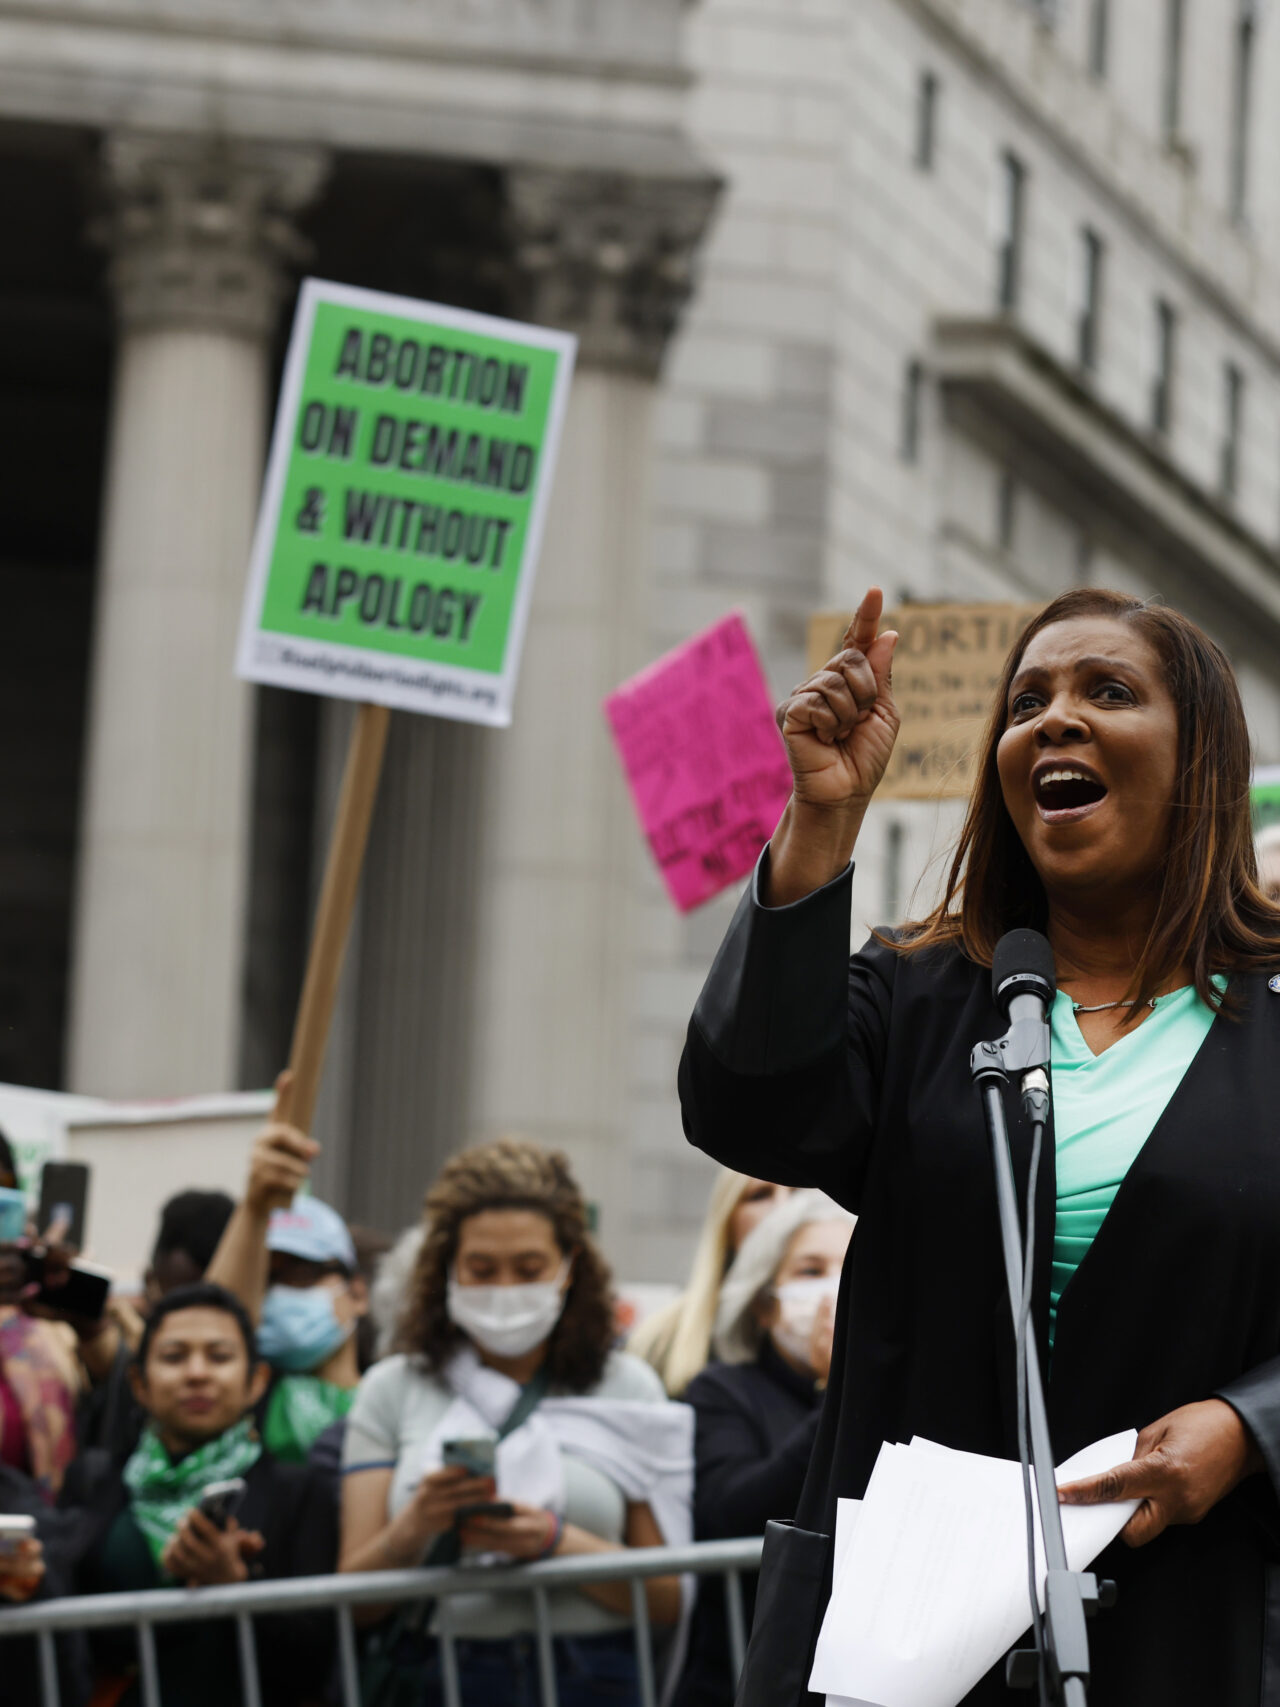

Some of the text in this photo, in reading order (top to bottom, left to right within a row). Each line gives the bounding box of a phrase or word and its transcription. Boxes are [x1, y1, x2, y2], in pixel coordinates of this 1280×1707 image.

[334, 327, 529, 414] ABORTION
[299, 401, 535, 494] ON DEMAND
[296, 486, 514, 572] & WITHOUT
[301, 561, 481, 643] APOLOGY
